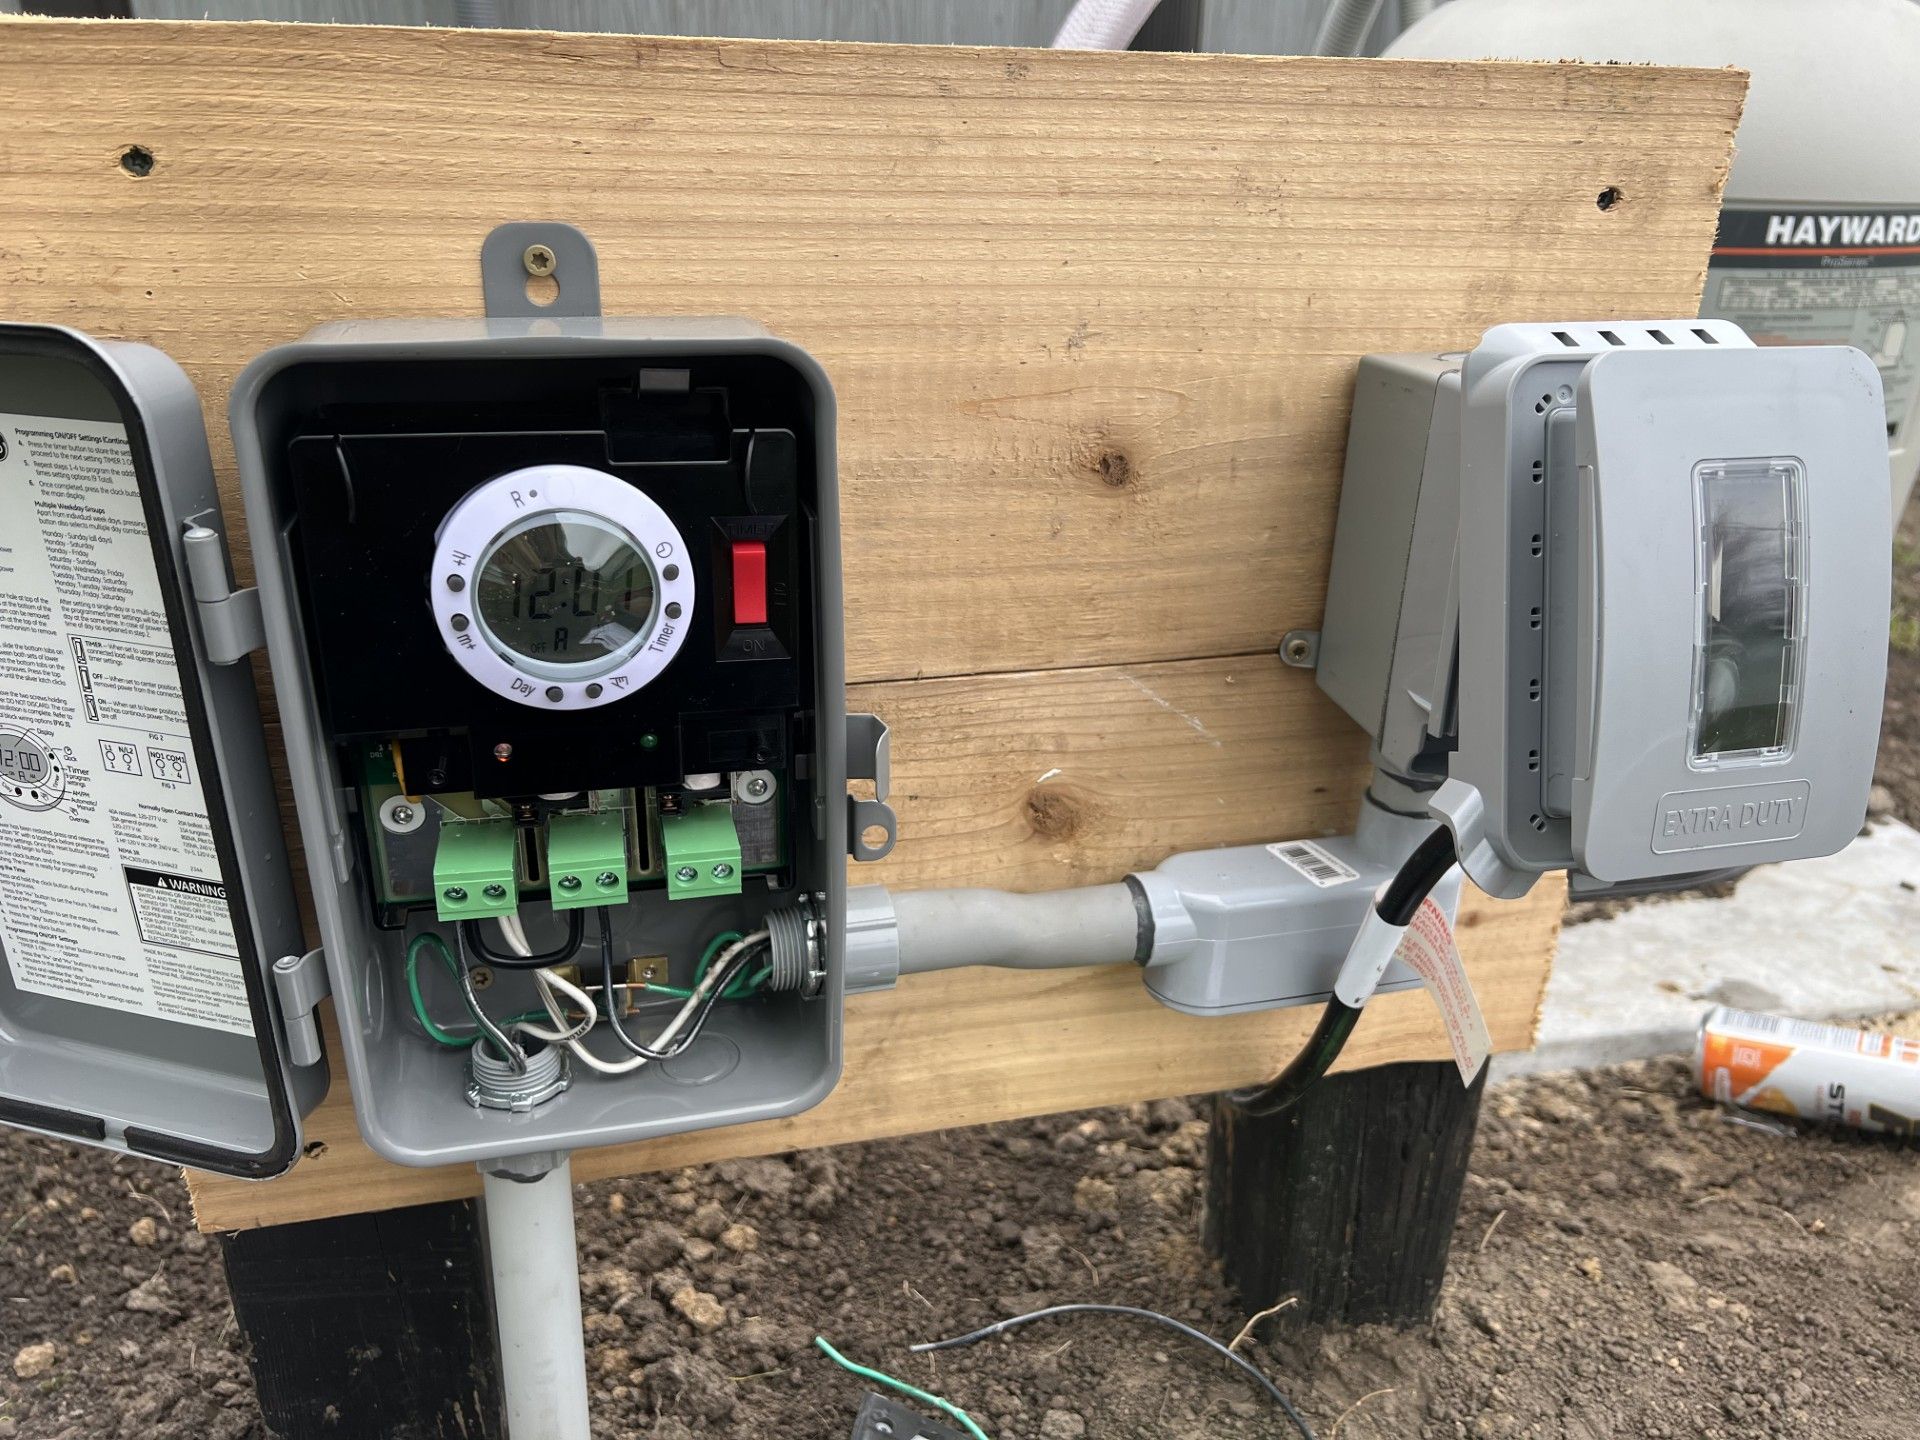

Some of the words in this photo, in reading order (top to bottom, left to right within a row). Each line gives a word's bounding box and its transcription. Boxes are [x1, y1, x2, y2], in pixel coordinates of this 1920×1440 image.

[1764, 214, 1920, 245] HAYWARD
[15, 428, 54, 439] Programming
[55, 432, 77, 440] ON/OFF
[78, 434, 102, 444] Settings
[30, 450, 53, 458] proceed
[83, 455, 103, 463] setting
[33, 461, 53, 469] Repeat
[85, 466, 111, 475] program
[51, 471, 70, 480] setting
[70, 473, 91, 482] options
[50, 490, 66, 499] main
[510, 490, 525, 508] R
[34, 501, 57, 509] Multiple
[57, 503, 84, 512] Weekday
[85, 506, 105, 514] Groups
[36, 509, 52, 517] Apart
[66, 512, 92, 521] individual
[92, 515, 106, 523] week
[122, 519, 146, 528] pressing
[88, 523, 110, 532] multiple
[41, 529, 64, 539] Monday
[67, 532, 88, 542] Sunday
[44, 538, 66, 547] Monday
[70, 541, 95, 551] Saturday
[46, 546, 68, 555] Monday
[71, 549, 89, 558] Friday
[48, 555, 72, 564] Saturday
[76, 558, 97, 567] Sunday
[107, 570, 125, 578] Friday
[103, 577, 128, 587] Saturday
[102, 586, 134, 595] Wednesday
[512, 567, 634, 620] 12:01
[101, 593, 126, 603] Saturday
[530, 642, 547, 655] OFF
[554, 627, 568, 651] A
[648, 622, 676, 653] Timer
[85, 641, 102, 649] TIMER
[743, 638, 766, 652] ON
[510, 677, 537, 698] Day
[48, 697, 67, 705] holding
[118, 746, 134, 754] N/L2
[150, 751, 165, 760] NO1
[166, 754, 186, 763] COM1
[67, 766, 89, 776] Timer
[138, 803, 161, 812] Normally
[161, 807, 175, 815] Open
[1662, 803, 1732, 837] EXTRA
[1739, 796, 1803, 829] DUTY
[169, 879, 227, 898] WARNING
[1422, 897, 1452, 946] RNING
